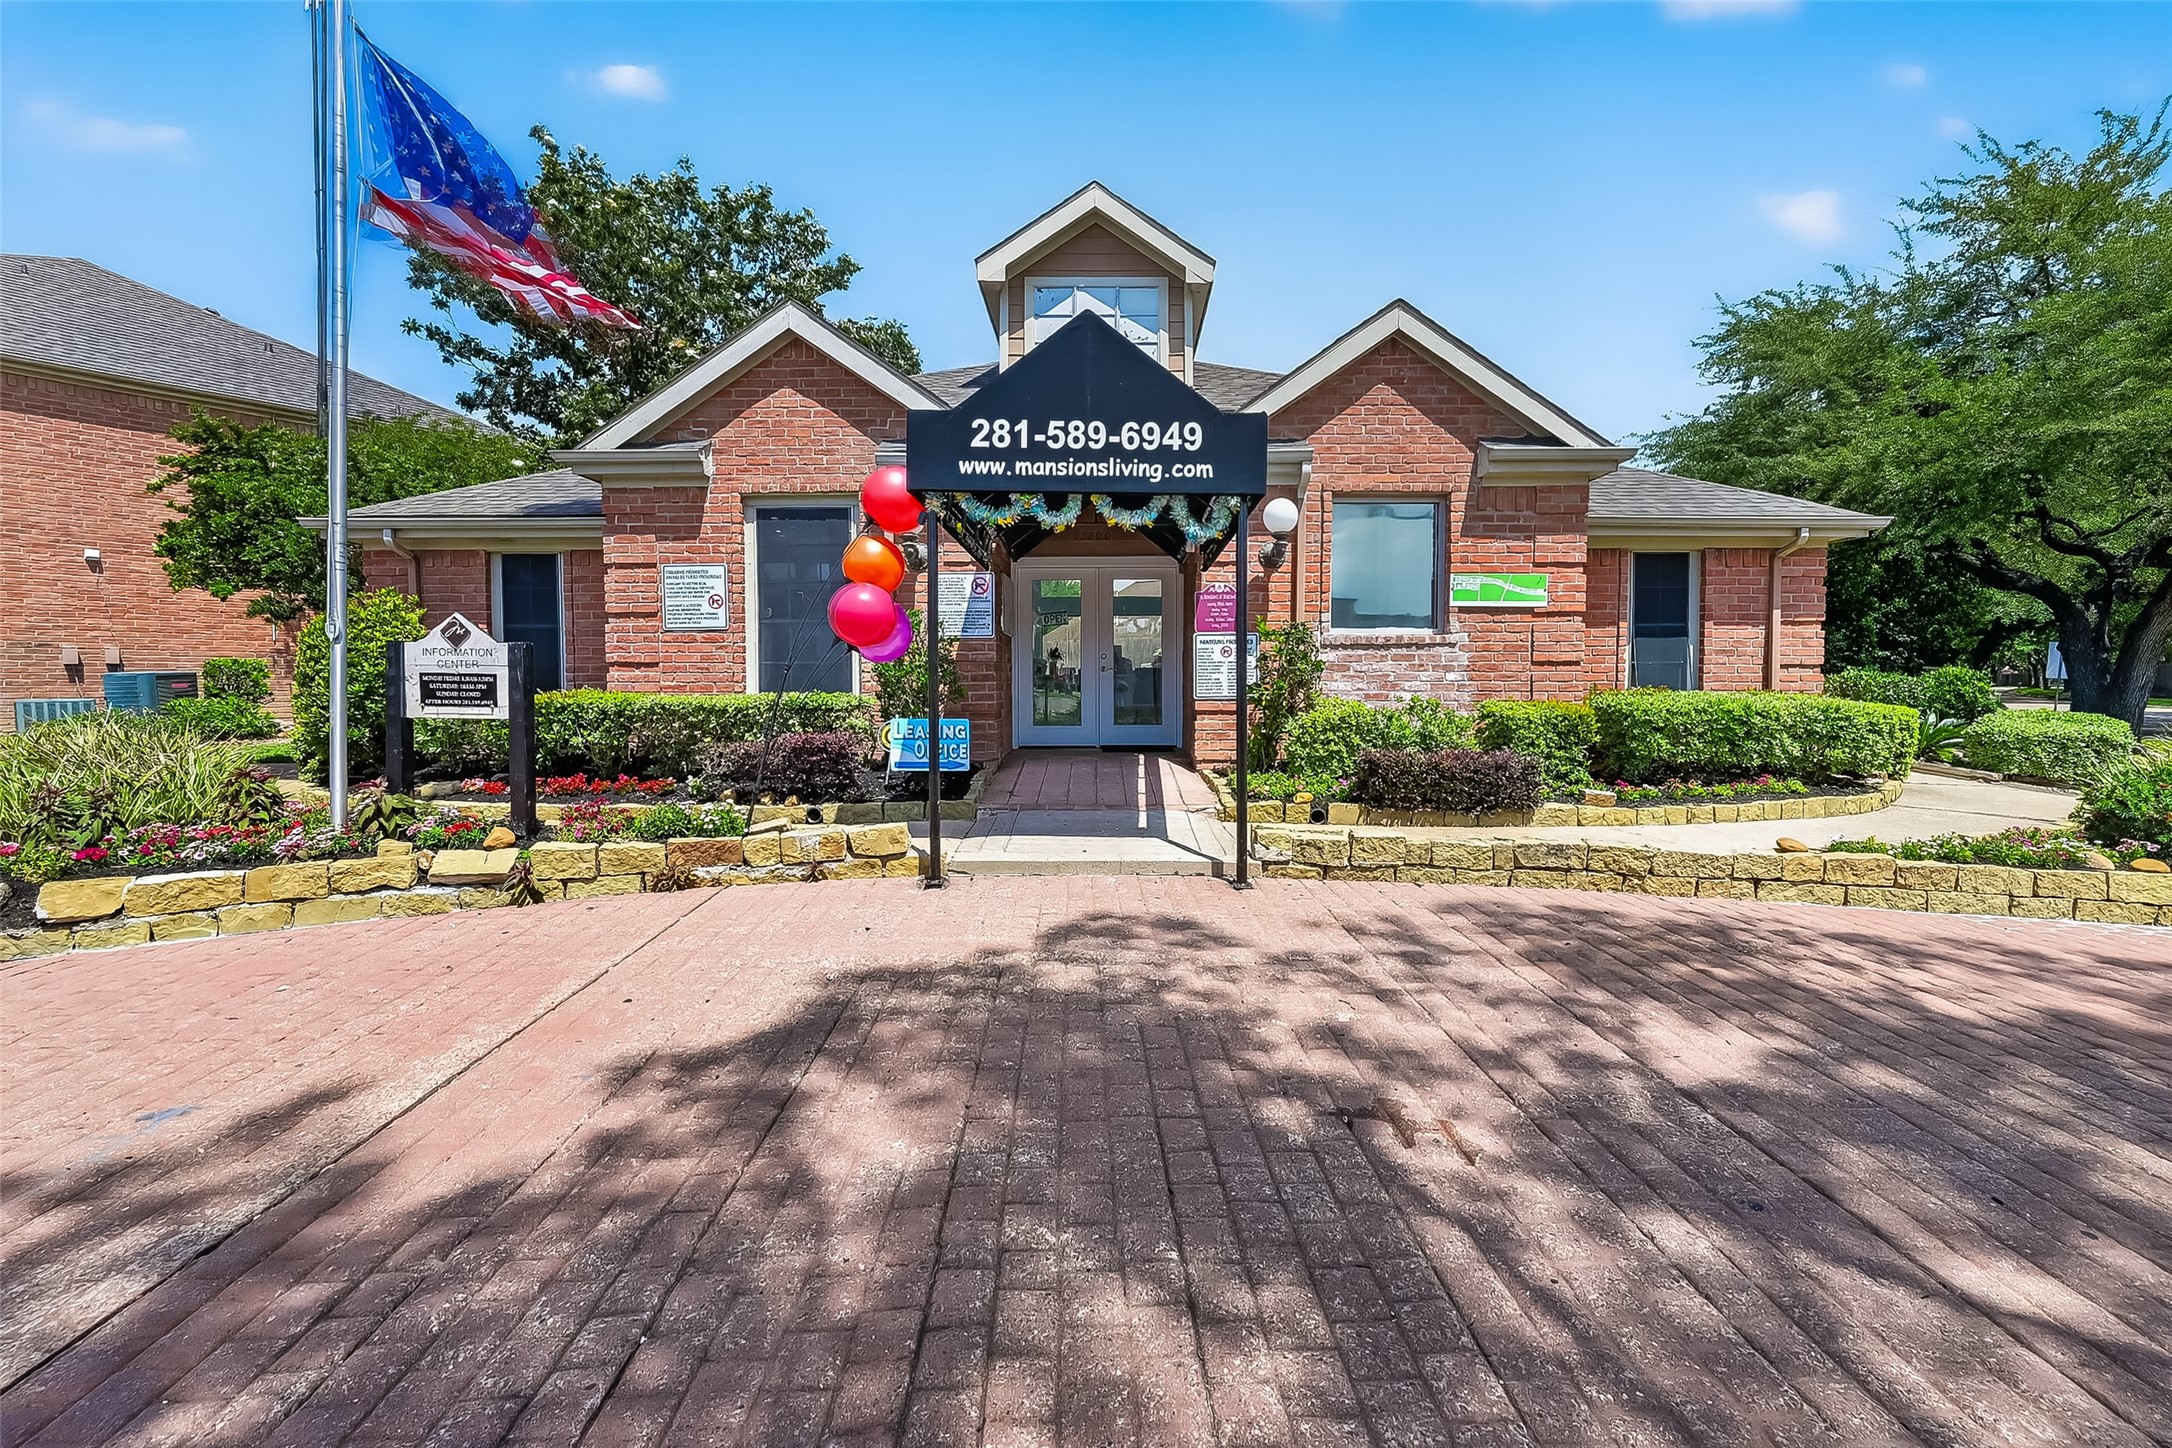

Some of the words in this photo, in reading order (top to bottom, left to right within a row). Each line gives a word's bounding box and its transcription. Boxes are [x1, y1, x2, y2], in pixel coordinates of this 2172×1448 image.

[970, 418, 1203, 451] 281-589-6949
[958, 457, 1214, 482] www.mansionsliving.com
[1043, 613, 1067, 624] OPEN
[422, 648, 493, 657] INFORMATION
[436, 659, 479, 669] CENTER
[894, 721, 966, 740] LEAING
[915, 741, 967, 759] OICE
